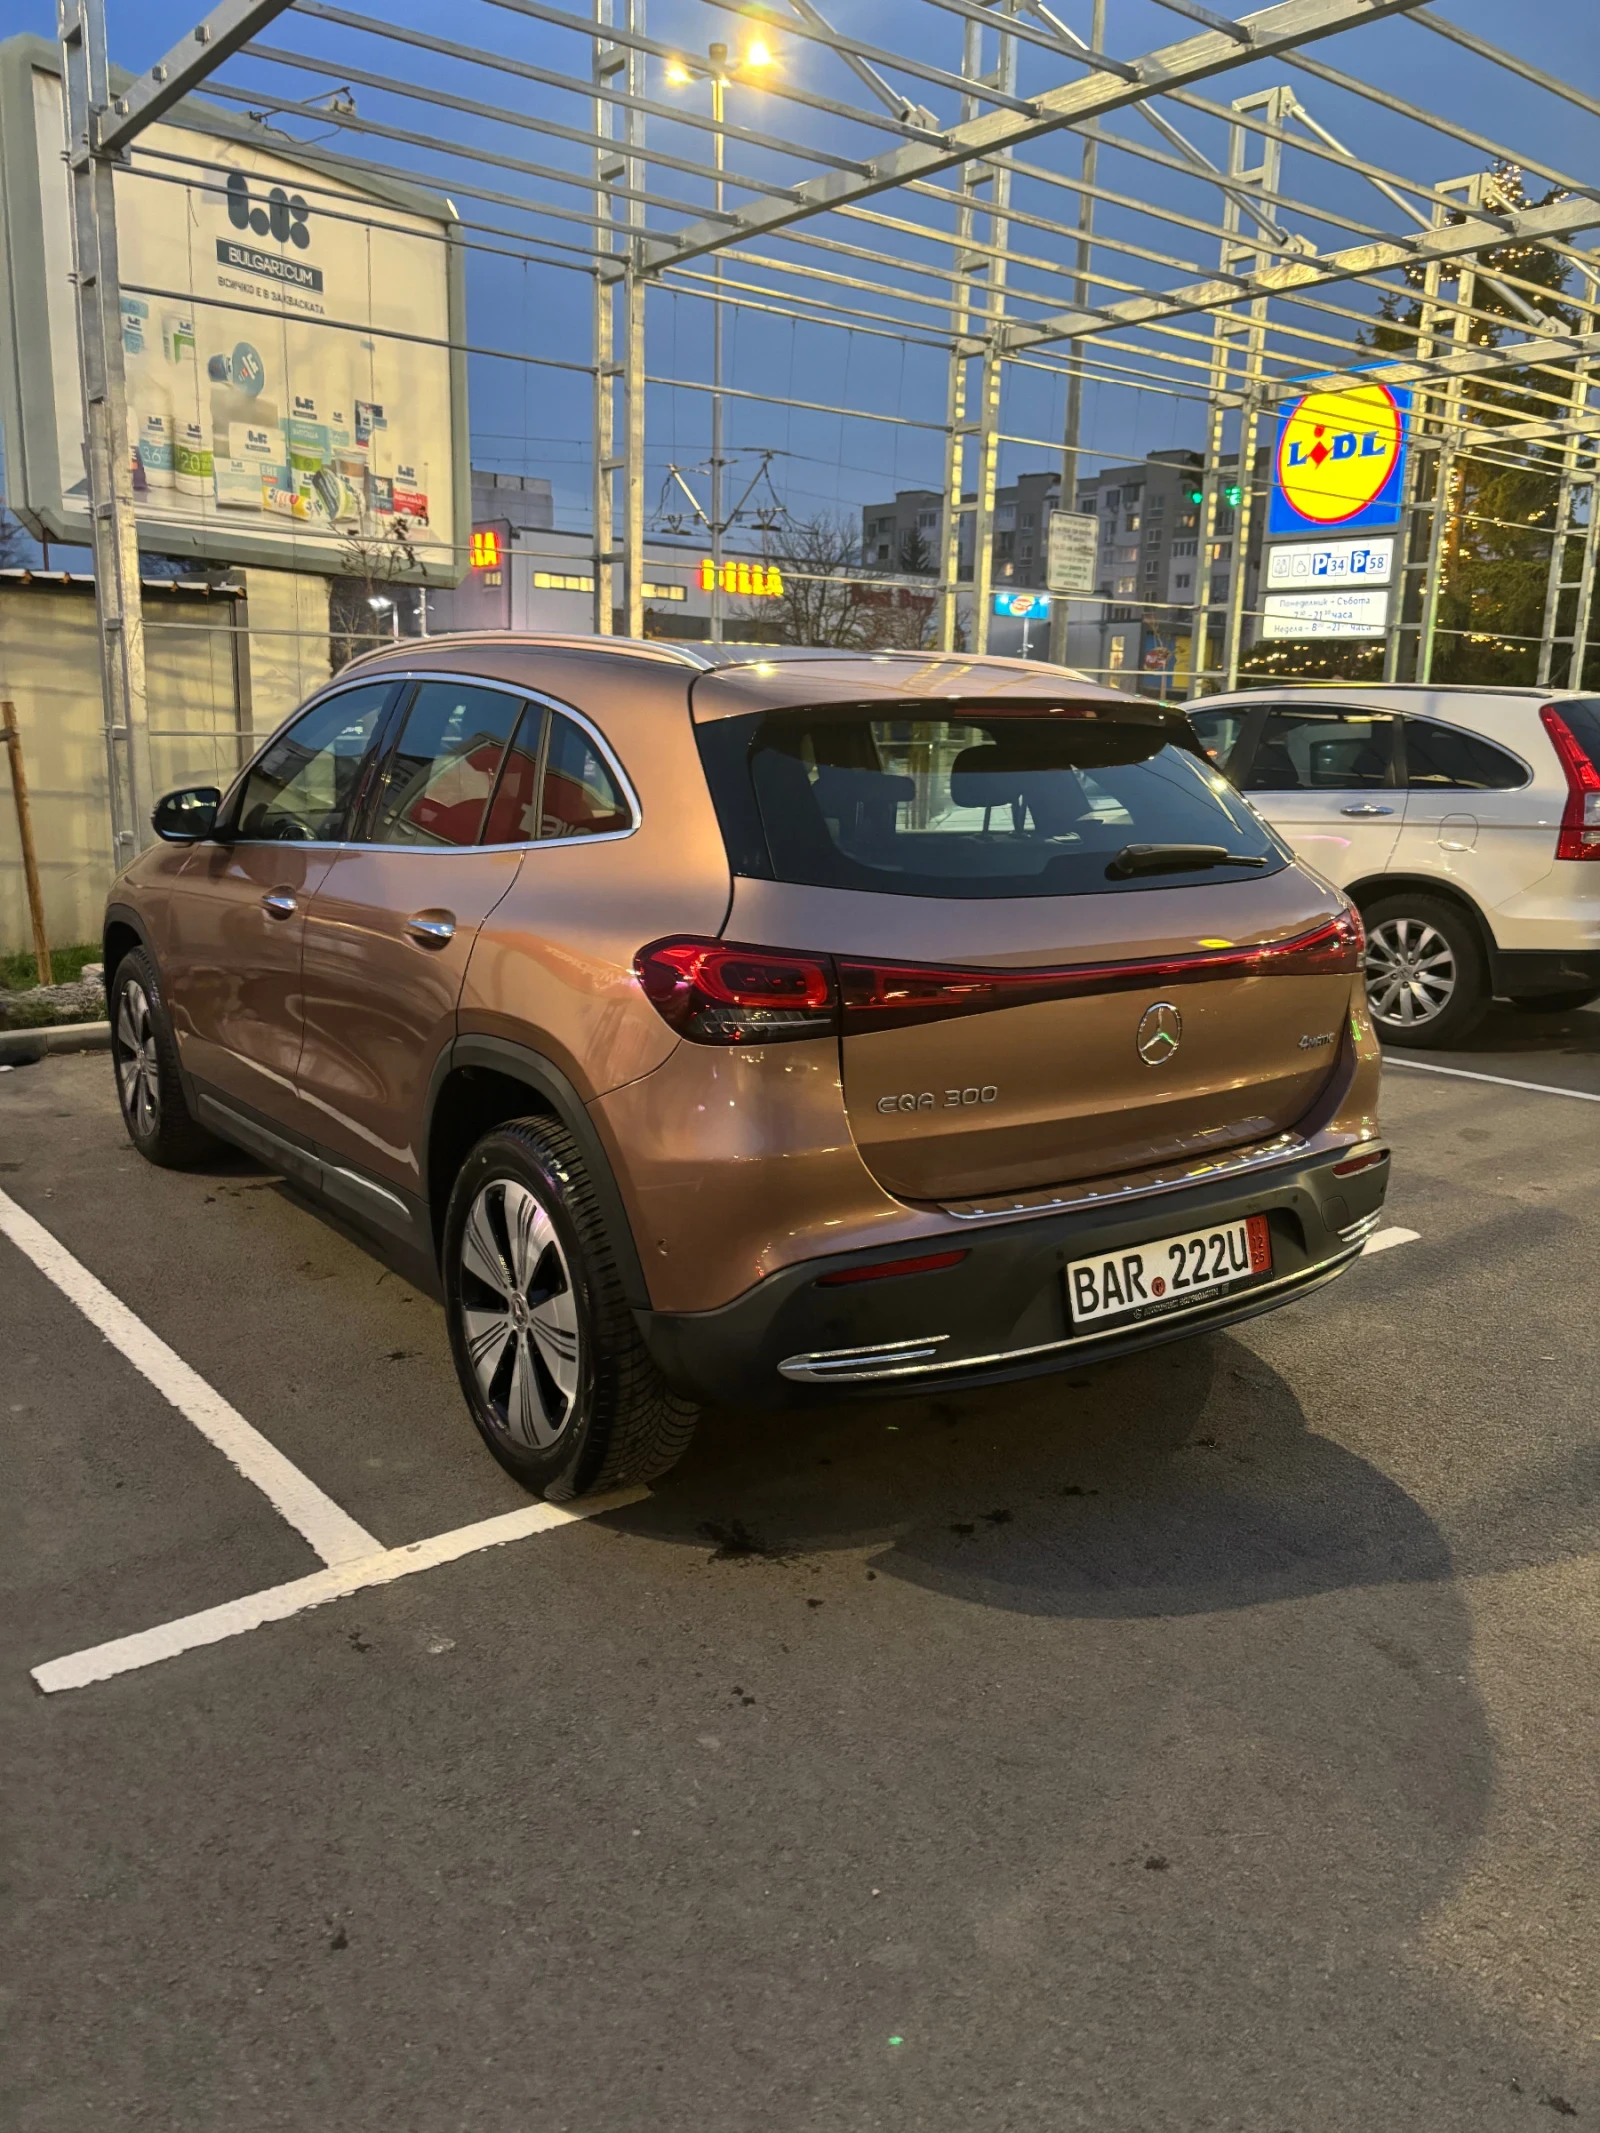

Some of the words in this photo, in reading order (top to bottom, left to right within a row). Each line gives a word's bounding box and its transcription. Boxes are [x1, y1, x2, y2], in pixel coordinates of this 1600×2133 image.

[228, 246, 313, 286] BULGARICUM
[217, 275, 255, 295] ВСИЧКО
[271, 291, 325, 315] ЗАКВАСКАТА
[1330, 559, 1345, 572] 34
[1369, 557, 1384, 570] 58
[1337, 597, 1371, 606] Събота
[1274, 625, 1303, 634] Неделя
[877, 1092, 935, 1113] EQA
[943, 1085, 998, 1107] 300
[1252, 1235, 1264, 1250] 12
[1250, 1251, 1265, 1265] 25
[1073, 1254, 1148, 1315] BAR
[1168, 1227, 1249, 1290] 222U
